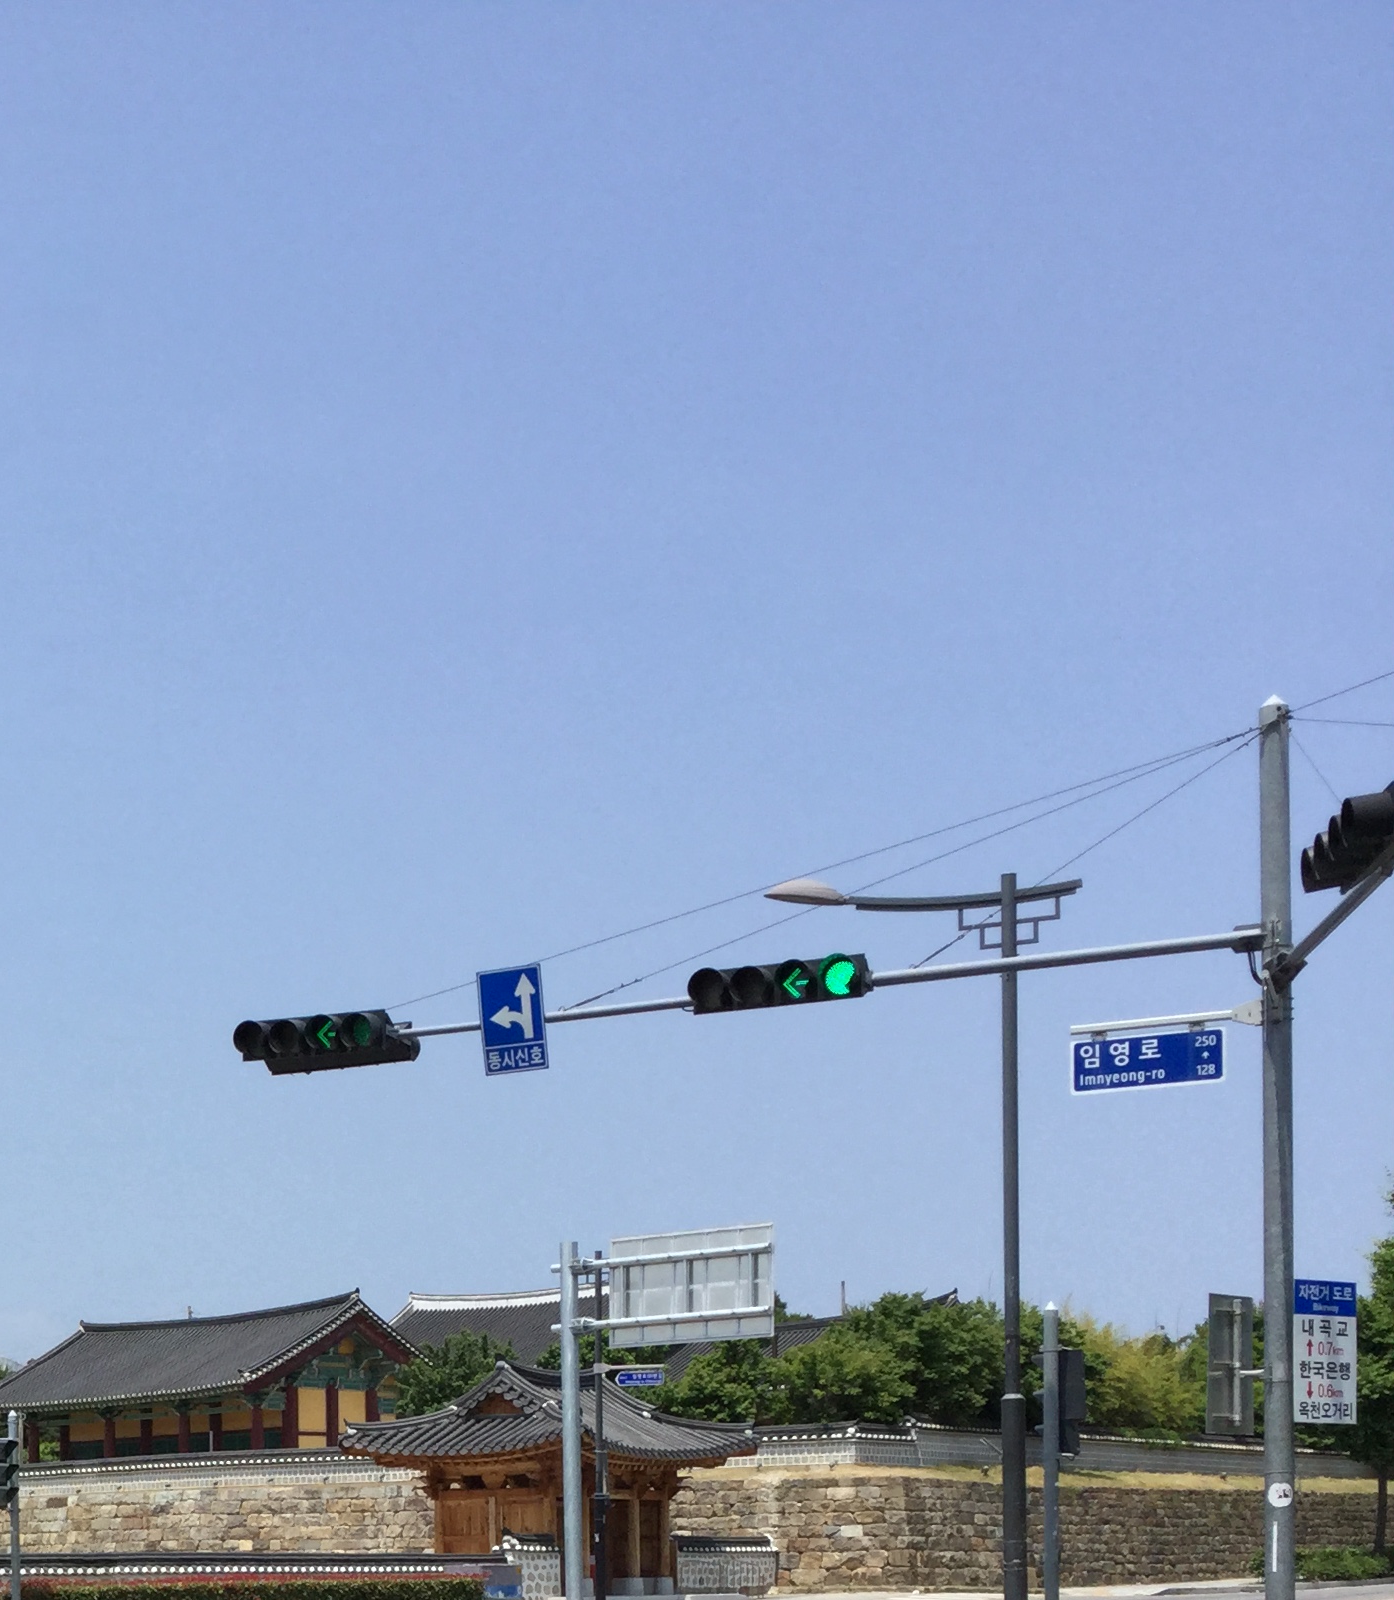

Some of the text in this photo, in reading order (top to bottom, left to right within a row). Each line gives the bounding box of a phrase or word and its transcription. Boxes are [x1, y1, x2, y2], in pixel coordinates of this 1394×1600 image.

[1195, 1035, 1216, 1047] 250
[488, 1047, 543, 1070] 동시신호
[1080, 1039, 1162, 1068] 임영로
[1080, 1069, 1166, 1086] Imnyeong-ro
[1197, 1064, 1216, 1076] 128
[1299, 1284, 1353, 1301] 자전거 도로
[1300, 1361, 1351, 1381] 한국은행
[1299, 1401, 1353, 1420] 옥천오거리
